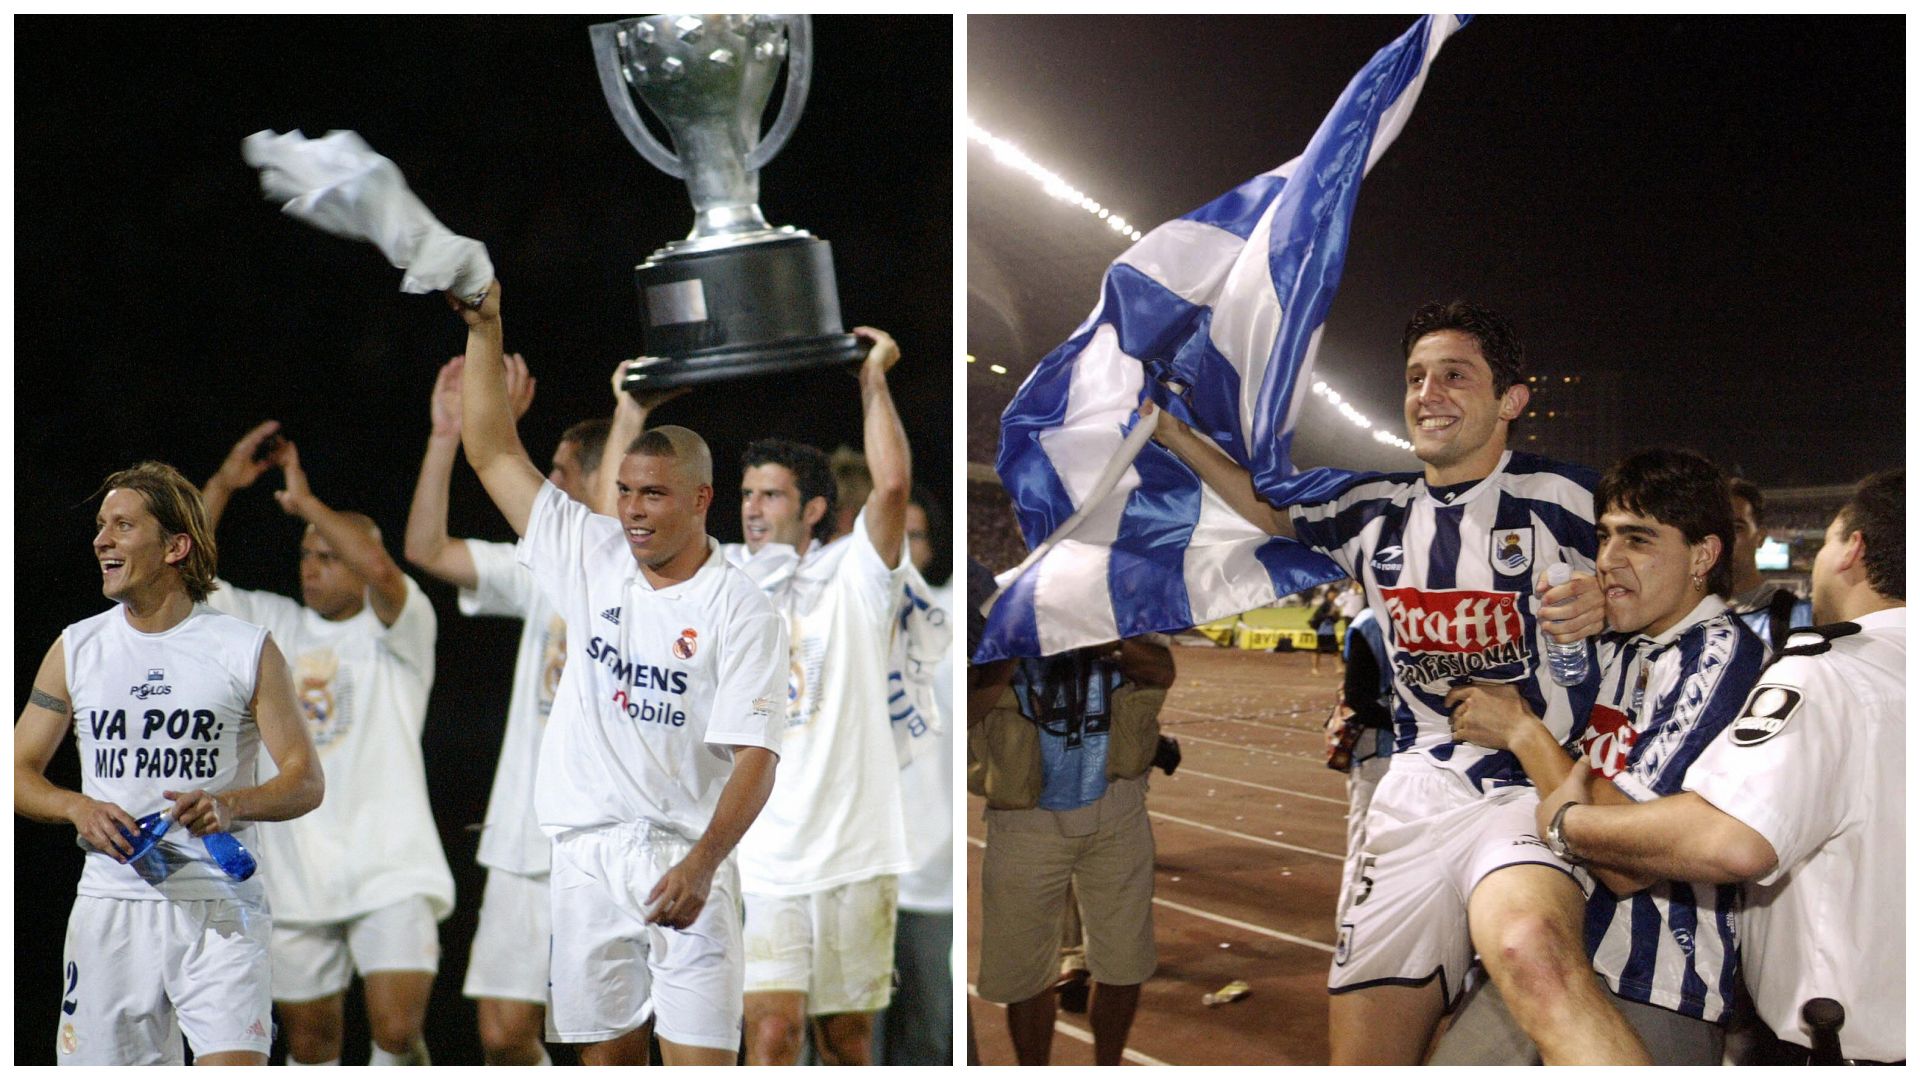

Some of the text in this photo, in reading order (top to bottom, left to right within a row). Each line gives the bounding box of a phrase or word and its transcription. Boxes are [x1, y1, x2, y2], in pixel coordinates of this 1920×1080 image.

[90, 708, 224, 742] VA POR:
[95, 747, 220, 780] MIS PADRES
